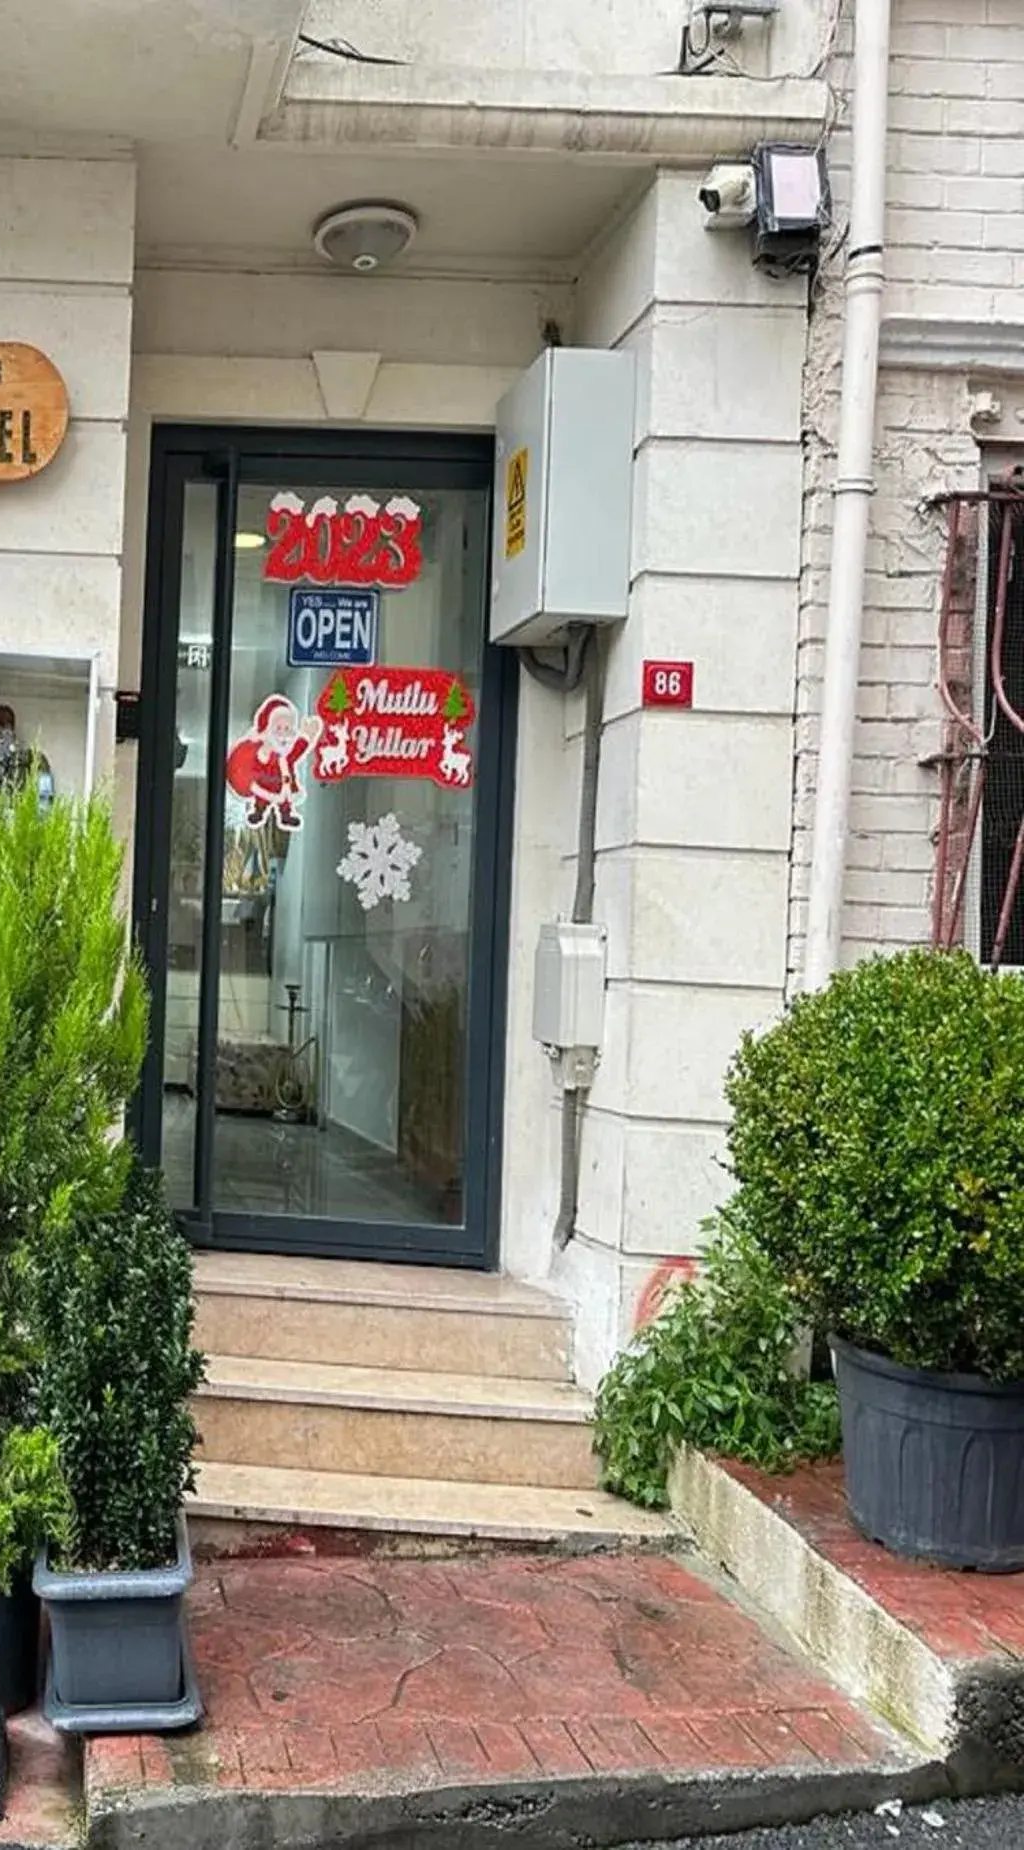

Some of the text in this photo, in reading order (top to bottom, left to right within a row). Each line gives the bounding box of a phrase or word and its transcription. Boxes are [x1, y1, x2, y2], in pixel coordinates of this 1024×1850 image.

[262, 492, 422, 588] 2023
[297, 608, 371, 650] OPEN
[354, 678, 438, 716] Mutlu
[655, 671, 681, 696] 86
